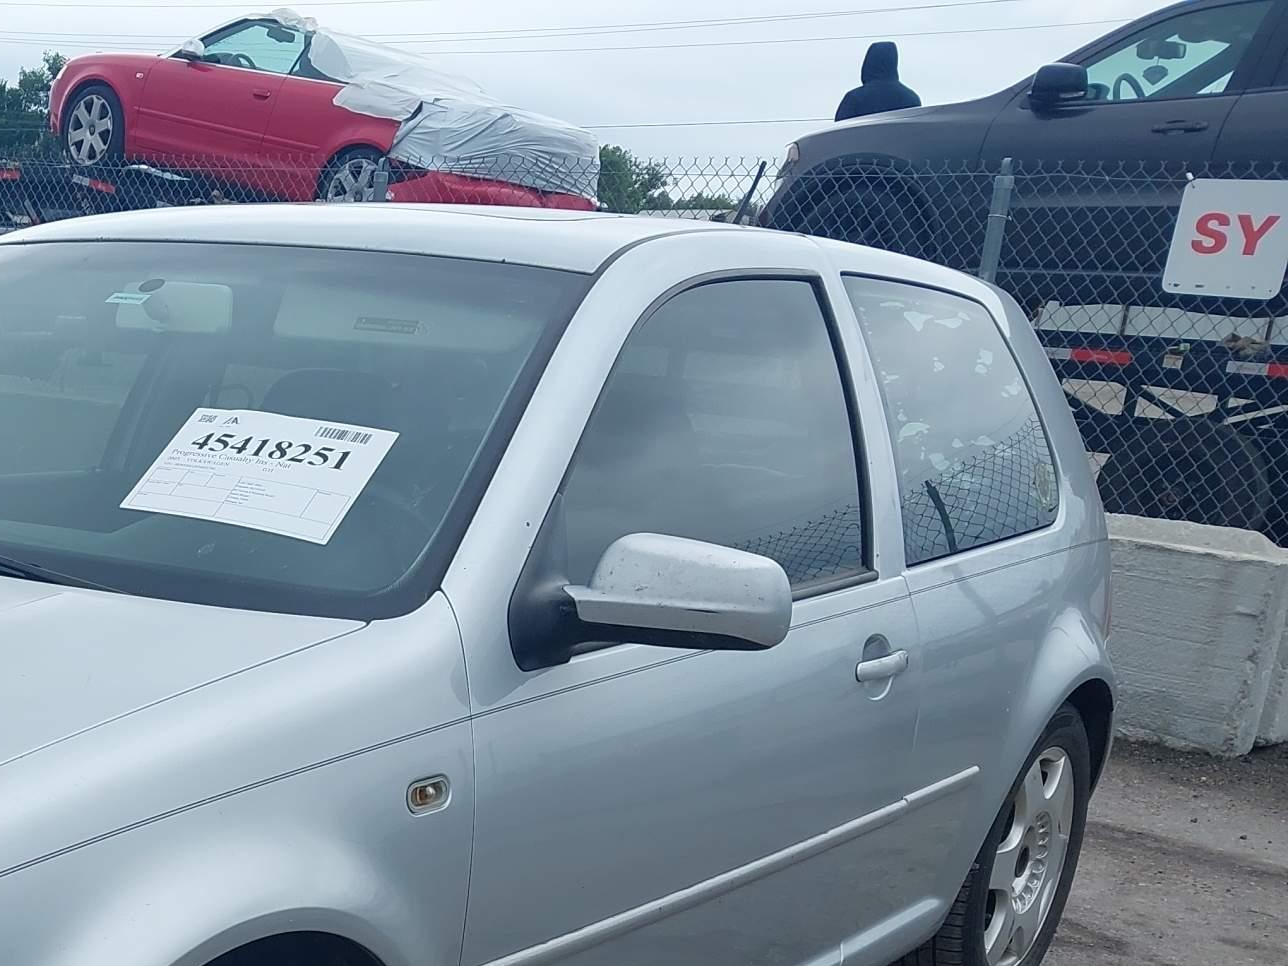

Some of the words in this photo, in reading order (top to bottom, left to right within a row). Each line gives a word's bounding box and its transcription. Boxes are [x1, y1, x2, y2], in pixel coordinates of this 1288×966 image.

[1190, 211, 1282, 256] SY
[171, 448, 217, 460] Progressive
[218, 453, 255, 465] Casualty
[275, 461, 292, 469] Nat
[191, 432, 353, 471] 45418251
